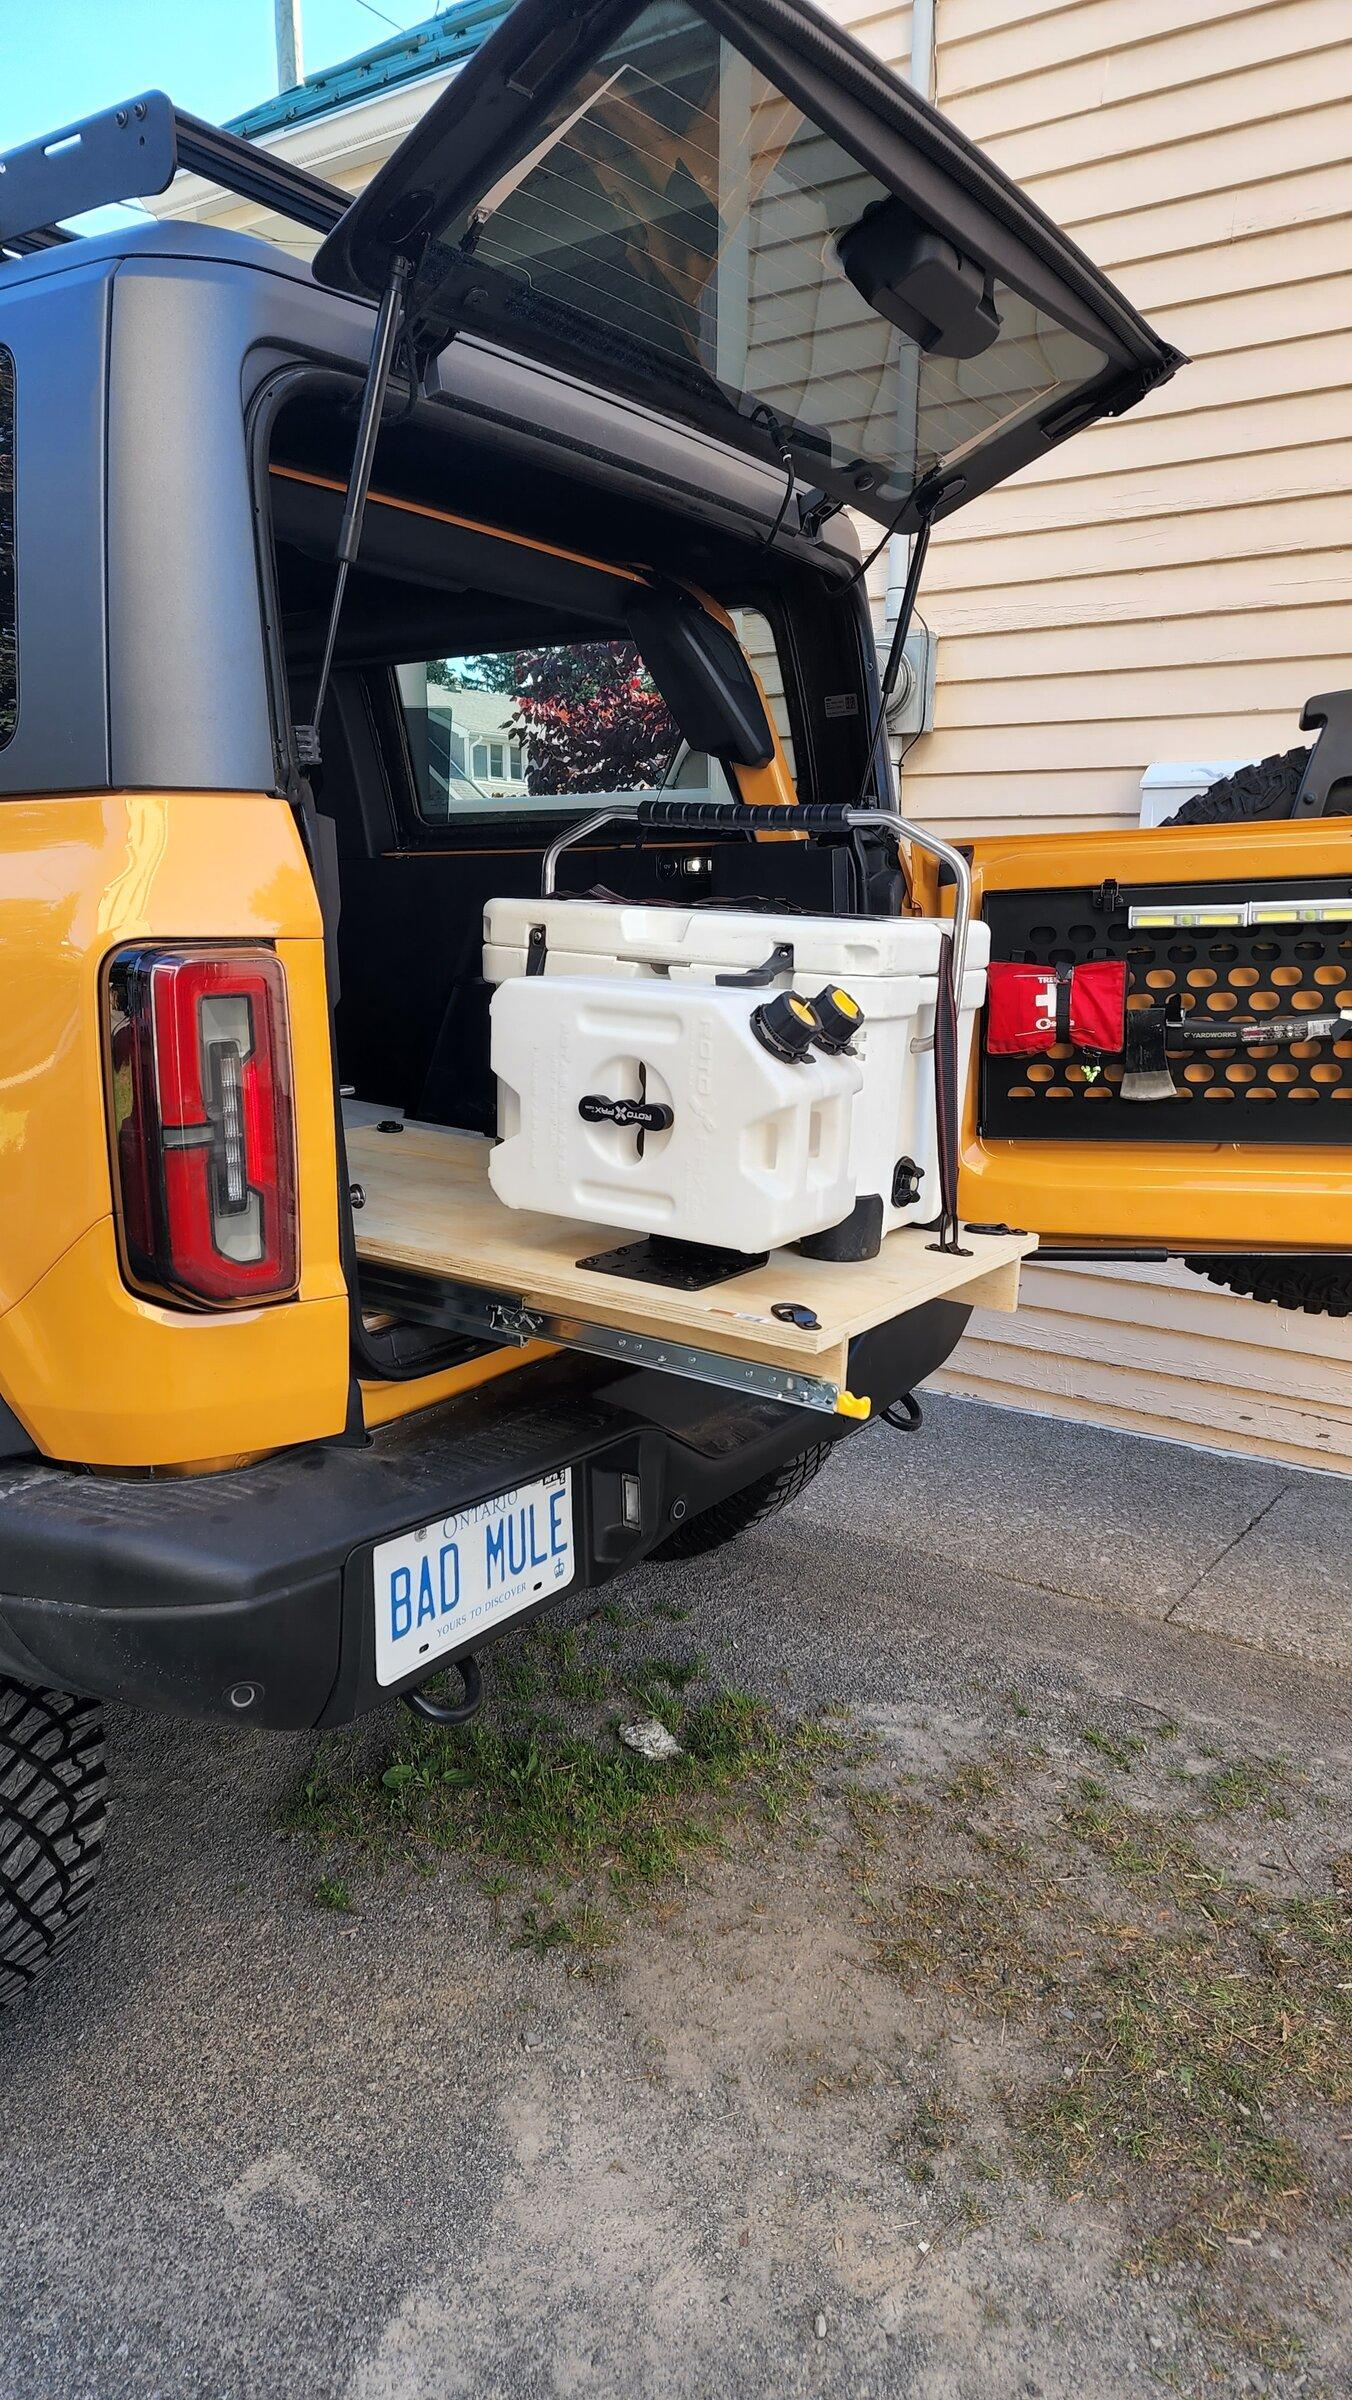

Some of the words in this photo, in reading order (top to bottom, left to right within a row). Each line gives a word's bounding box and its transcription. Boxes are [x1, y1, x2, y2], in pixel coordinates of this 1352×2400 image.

[1191, 1031, 1237, 1039] YARDWORKS
[443, 1490, 518, 1538] ONTARIO
[390, 1543, 460, 1642] BAD
[486, 1489, 568, 1590] MULE
[436, 1614, 467, 1637] YOURS
[470, 1606, 482, 1619] TO
[484, 1582, 527, 1611] DISCOVER
